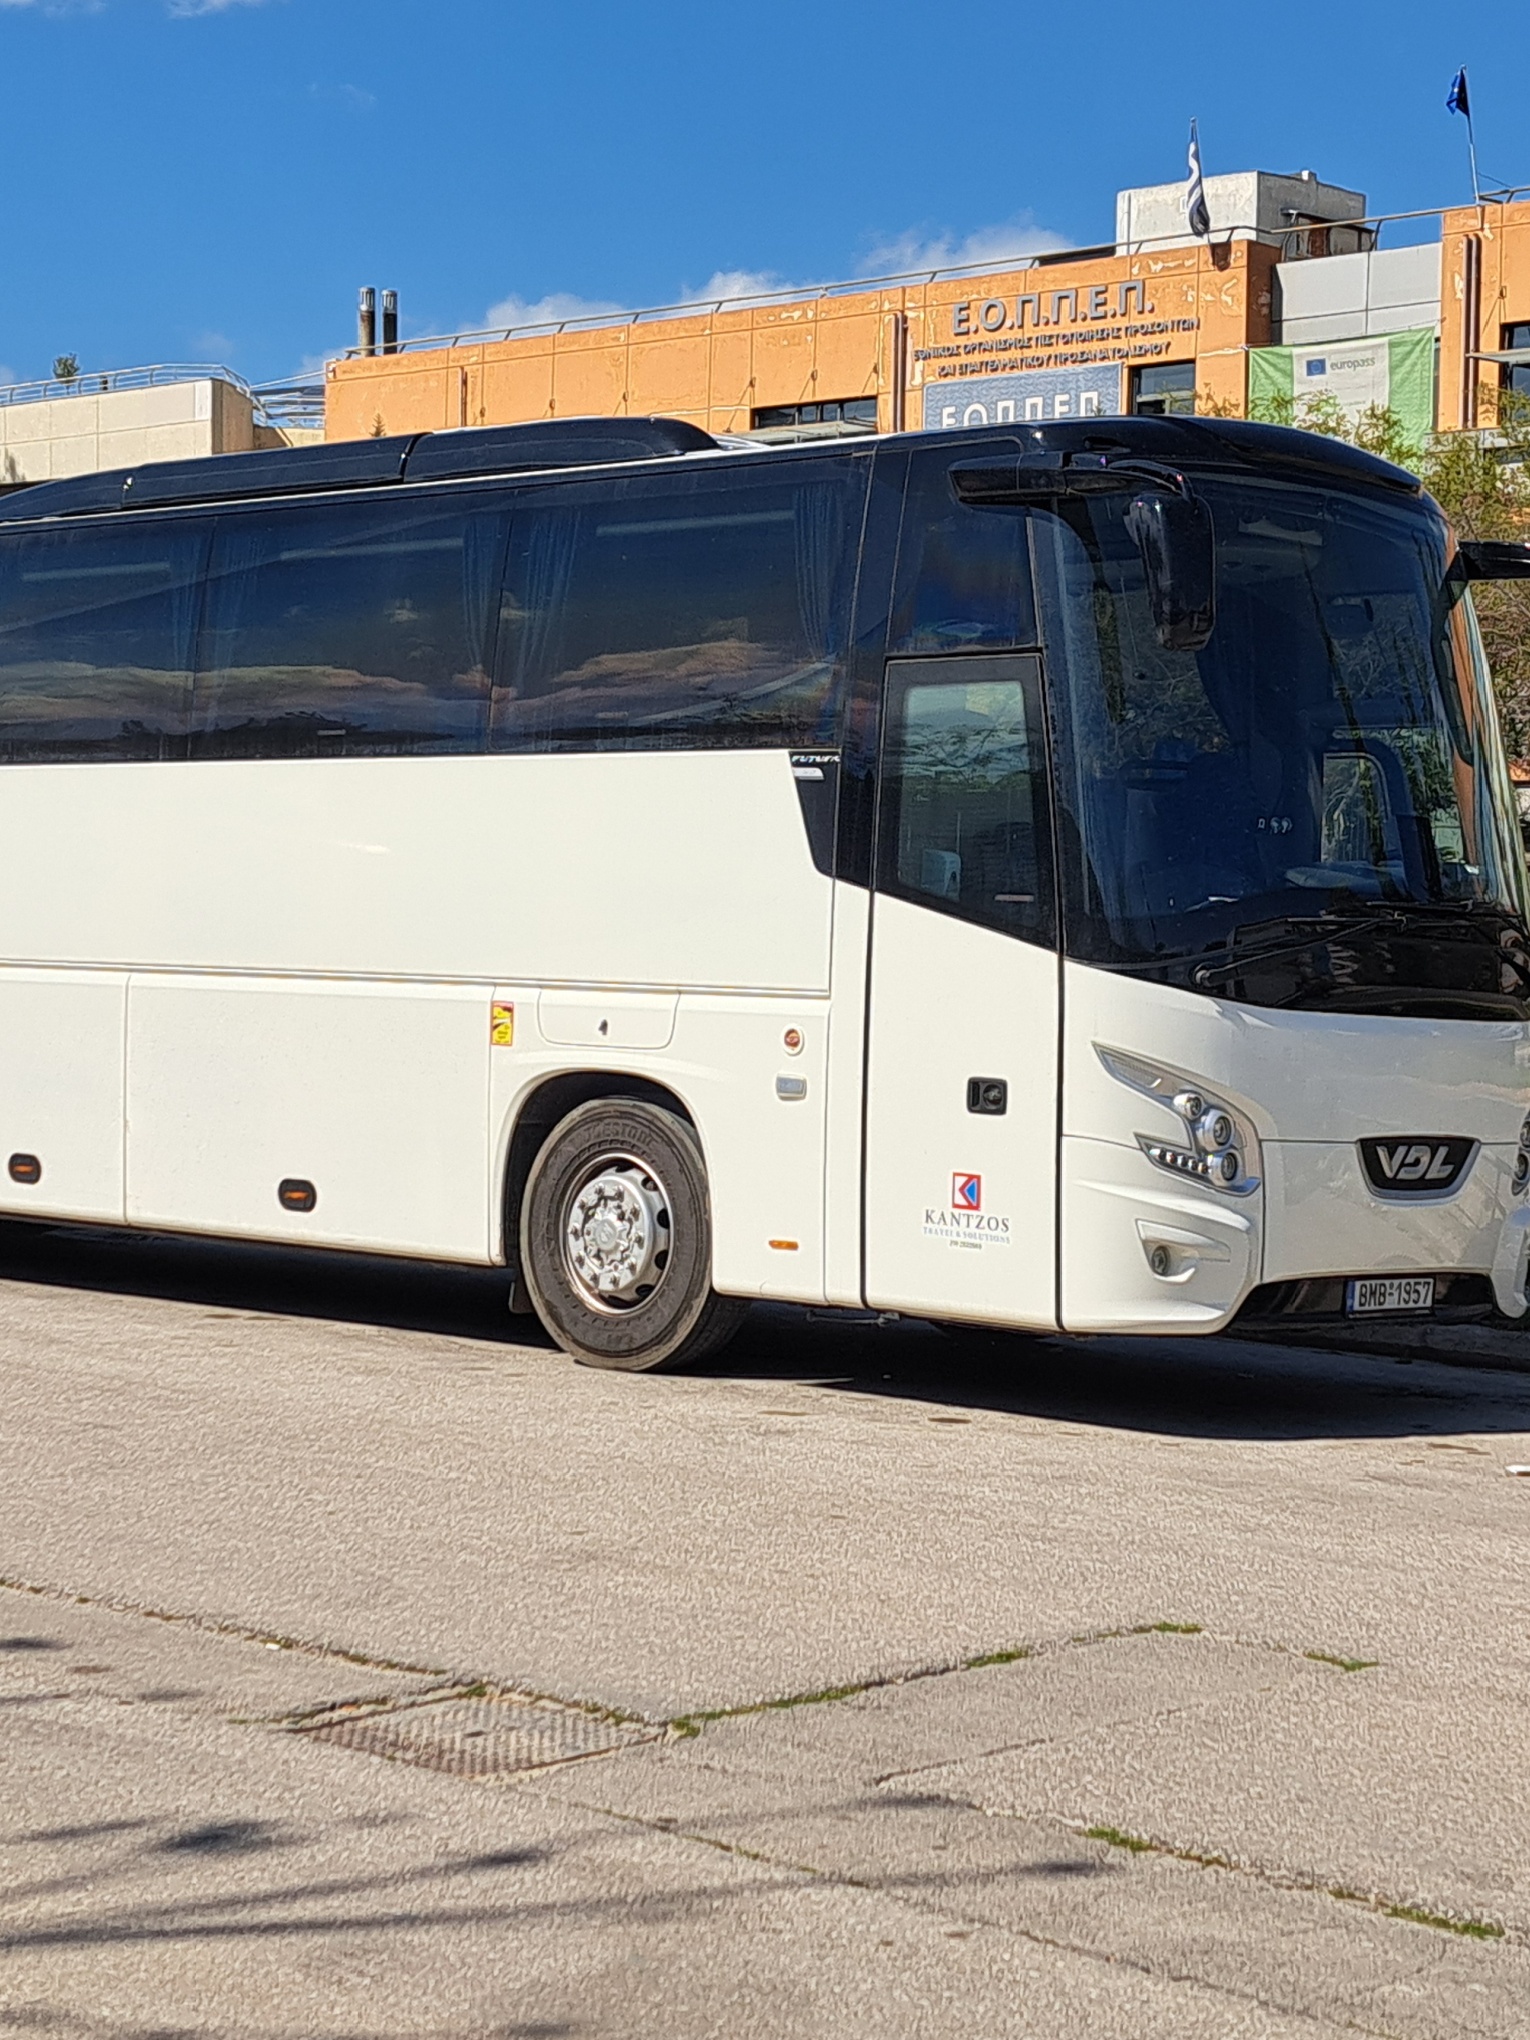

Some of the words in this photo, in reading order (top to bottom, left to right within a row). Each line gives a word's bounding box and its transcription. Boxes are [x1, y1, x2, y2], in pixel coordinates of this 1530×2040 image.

[953, 279, 1154, 335] Ε.Ο.Π.Π.Ε.Π.
[963, 335, 1034, 356] ΟΡΓΑΝΙΣΜΟΣ
[1035, 326, 1122, 349] ΠΙΣΤΟΠΟΙΗΣΗΣ
[1124, 317, 1200, 338] ΠΡΟΣΟΝΤΩΝ
[938, 363, 957, 378] ΚΑΙ
[959, 353, 1052, 376] ΕΠΑΓΓΕΛΜΑΤΙΚΟΥ
[1053, 341, 1171, 367] ΠΡΟΣΑΝΑΤΟΛΙΣΜΟΥ
[1330, 356, 1376, 371] europass
[1375, 1145, 1456, 1180] VDL
[923, 1226, 953, 1237] TRAVEL
[963, 1231, 1010, 1244] SOLUTIONS
[925, 1209, 1010, 1233] KANTZOS
